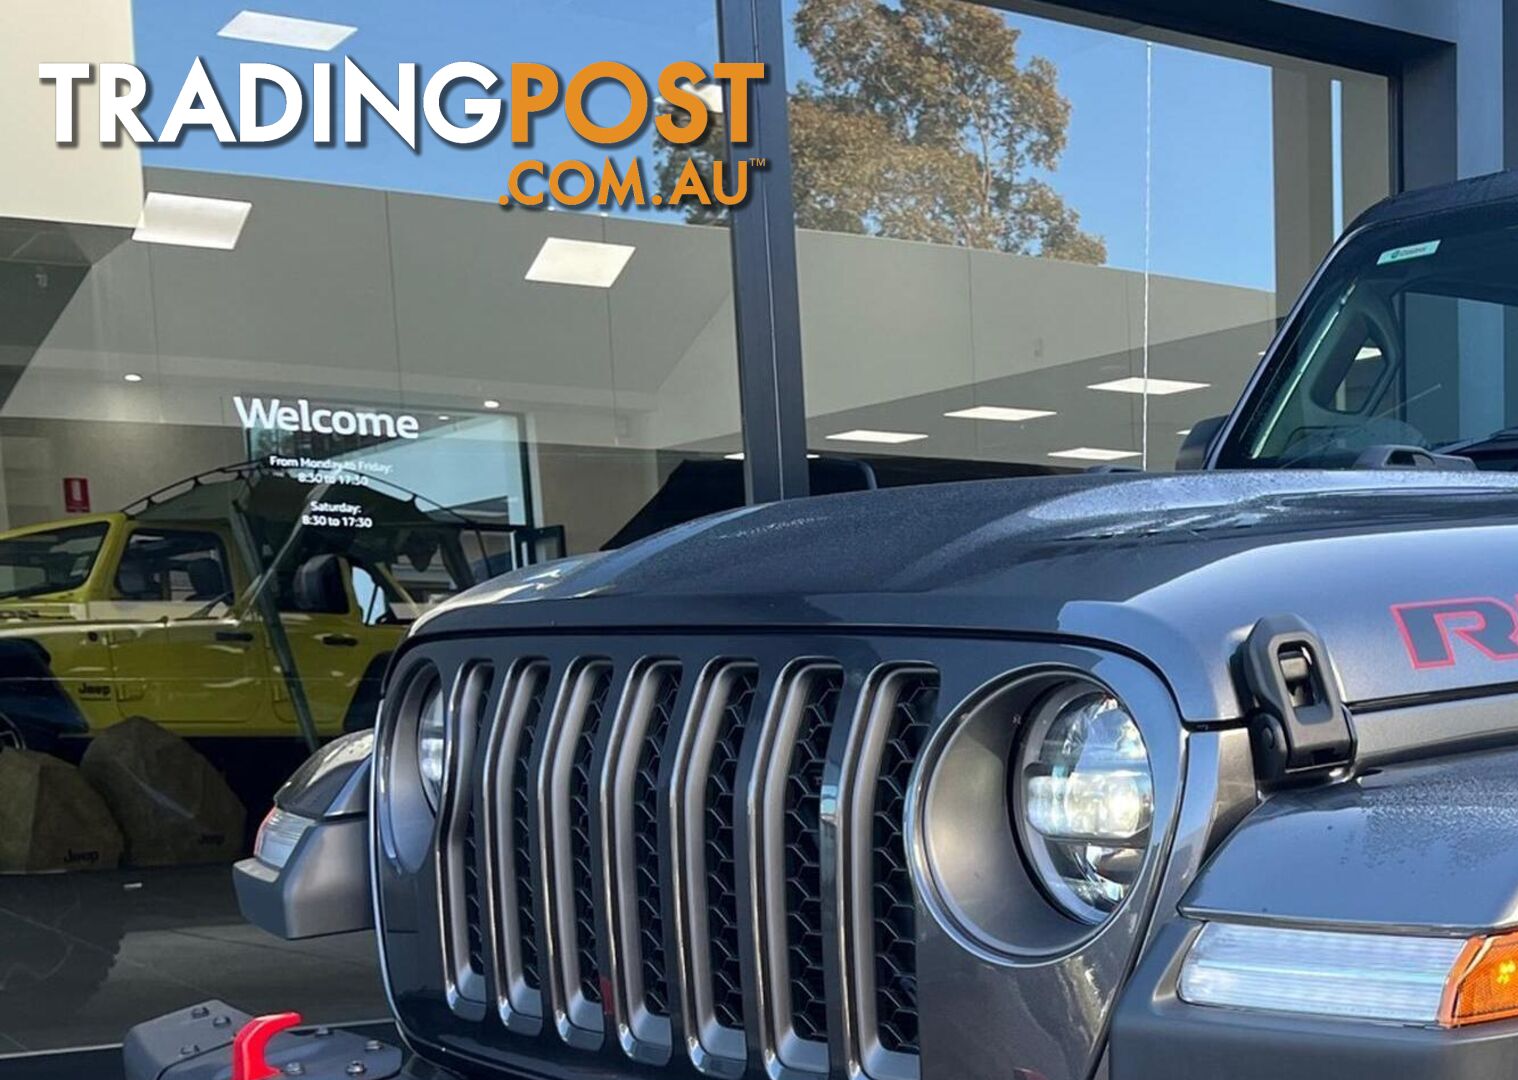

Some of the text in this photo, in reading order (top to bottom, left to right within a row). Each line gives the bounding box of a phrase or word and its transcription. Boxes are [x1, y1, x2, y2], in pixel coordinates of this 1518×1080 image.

[233, 396, 419, 439] Welcome
[269, 455, 298, 468] From
[300, 457, 345, 473] Monday
[324, 474, 336, 485] to
[310, 500, 361, 515] Saturday:
[302, 514, 373, 528] 8:30 to 17:30
[78, 682, 111, 697] Jeep
